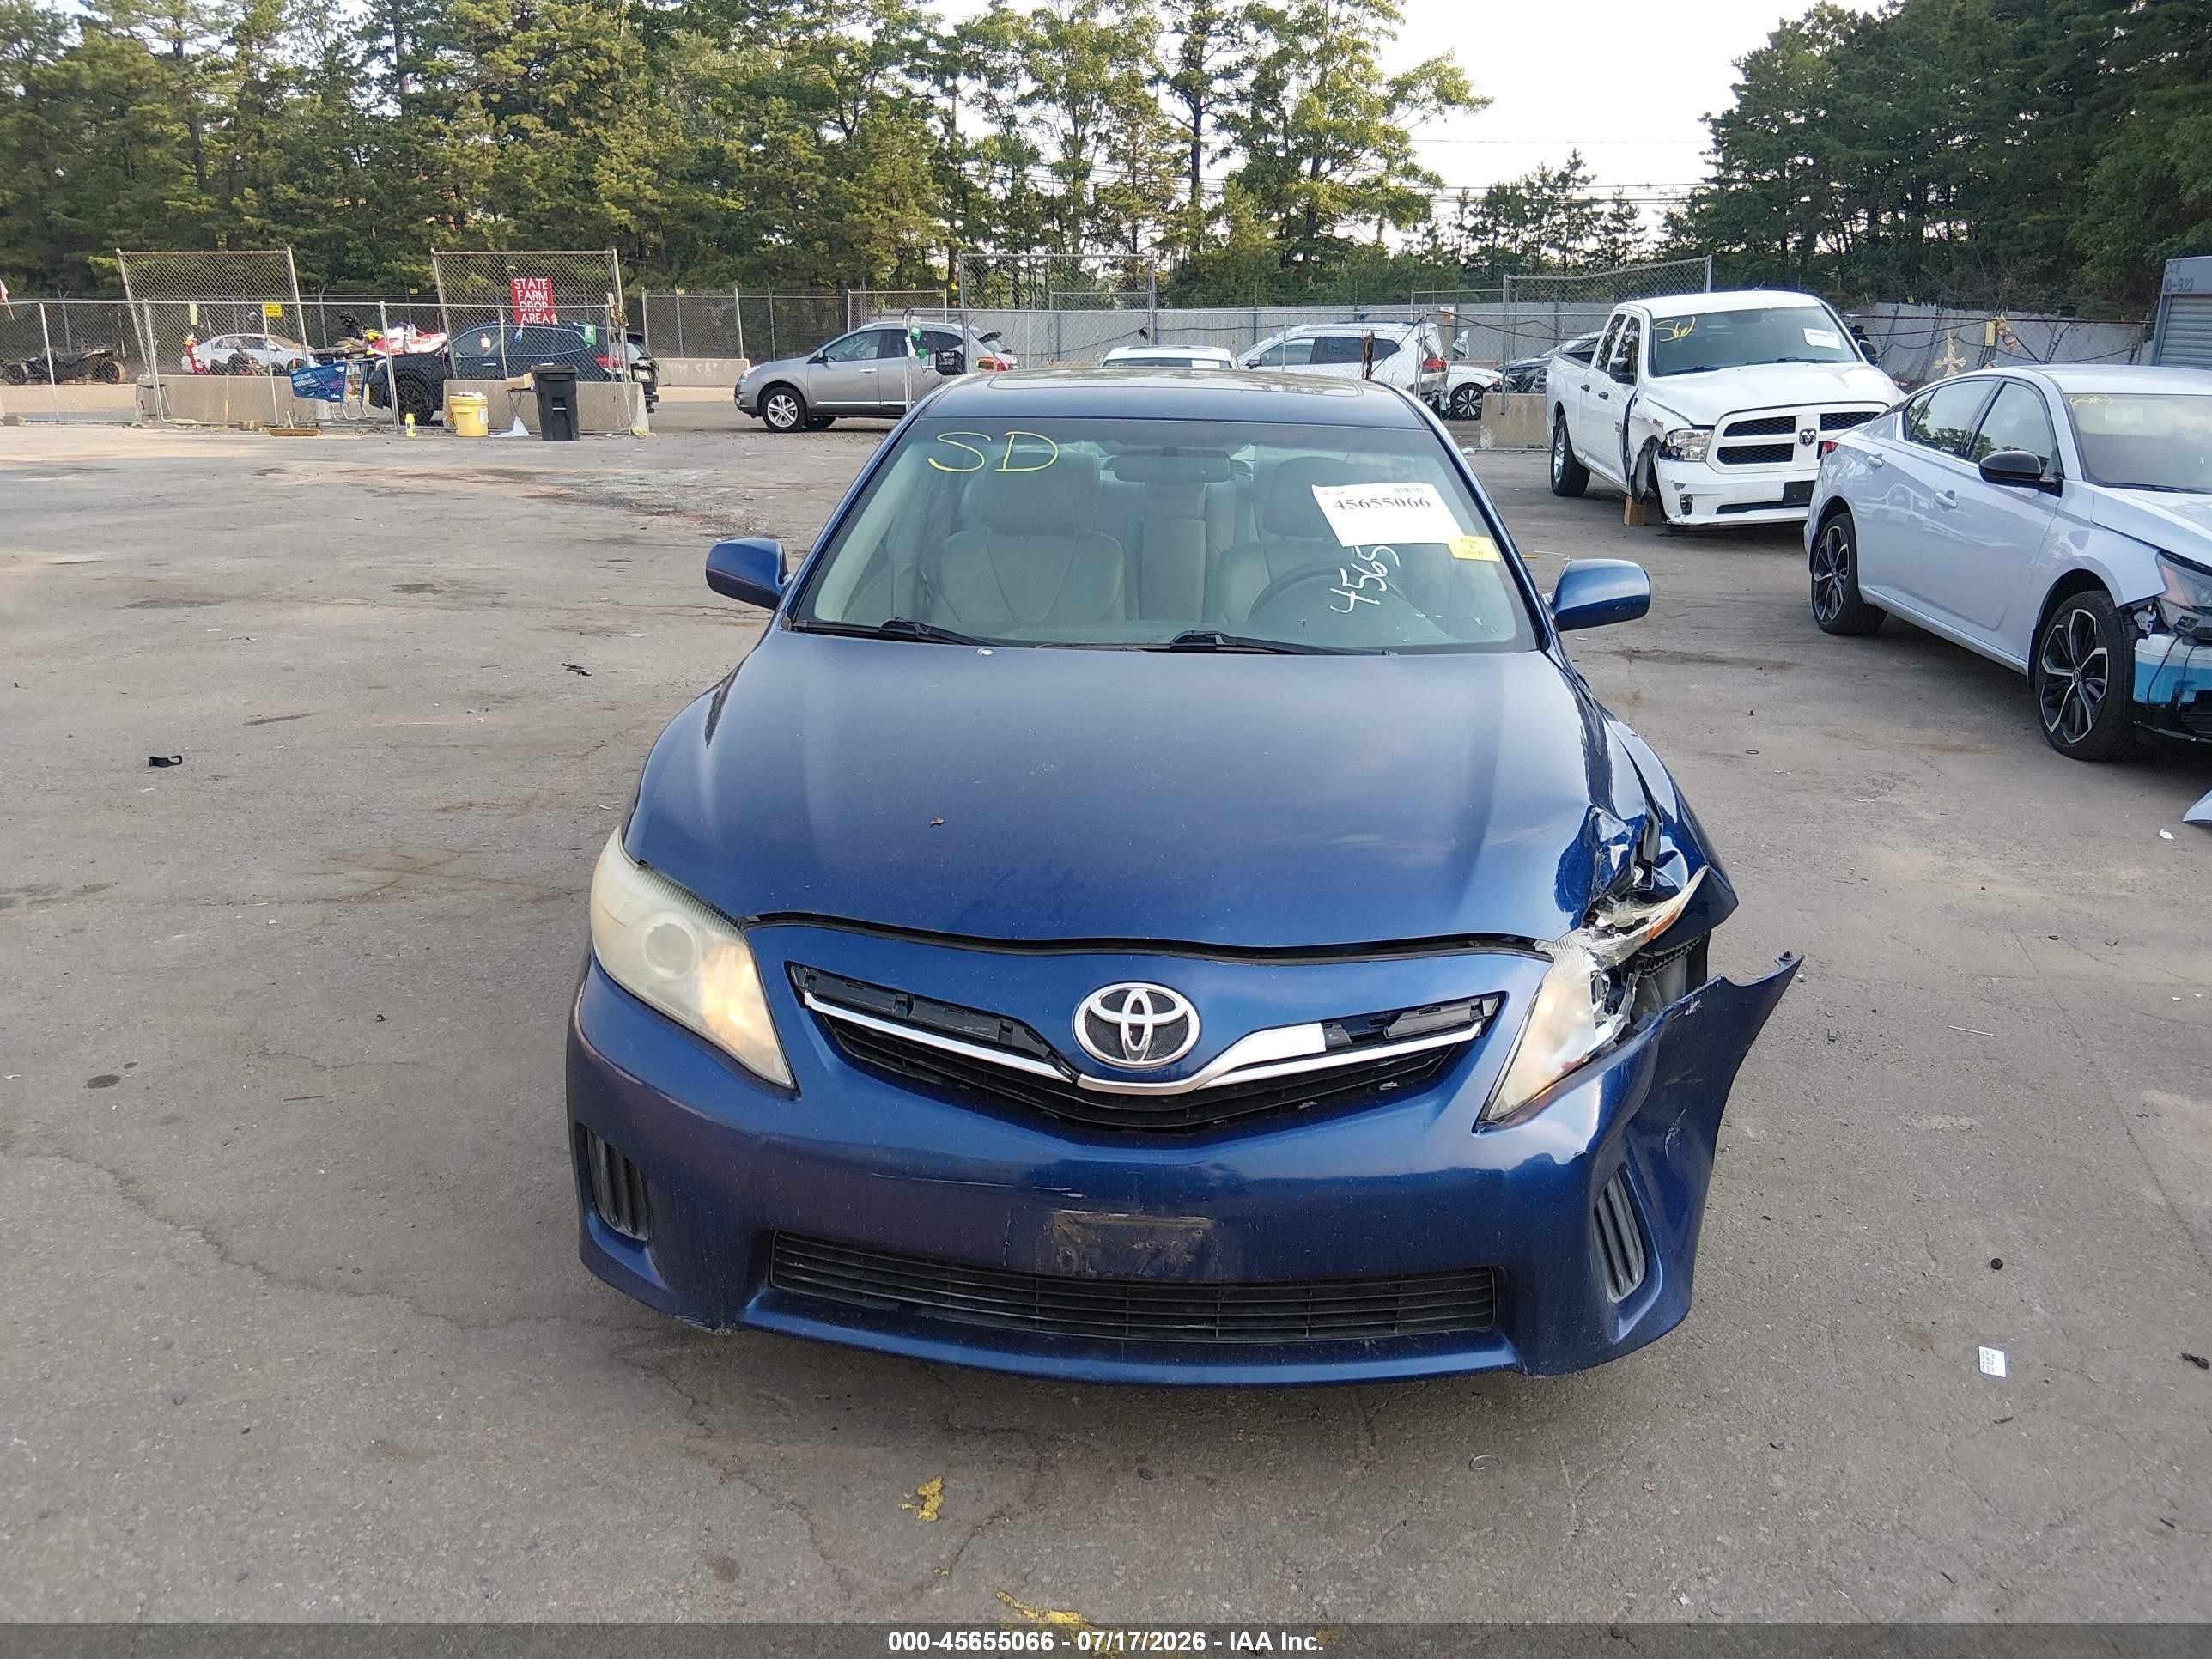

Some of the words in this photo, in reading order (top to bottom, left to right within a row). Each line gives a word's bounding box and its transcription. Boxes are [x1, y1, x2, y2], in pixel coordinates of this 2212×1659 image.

[514, 278, 548, 289] STATE
[517, 290, 548, 301] FARM
[519, 301, 548, 312] DROP
[520, 313, 550, 324] AREA
[927, 430, 1058, 472] SD
[1334, 496, 1431, 510] 45655066
